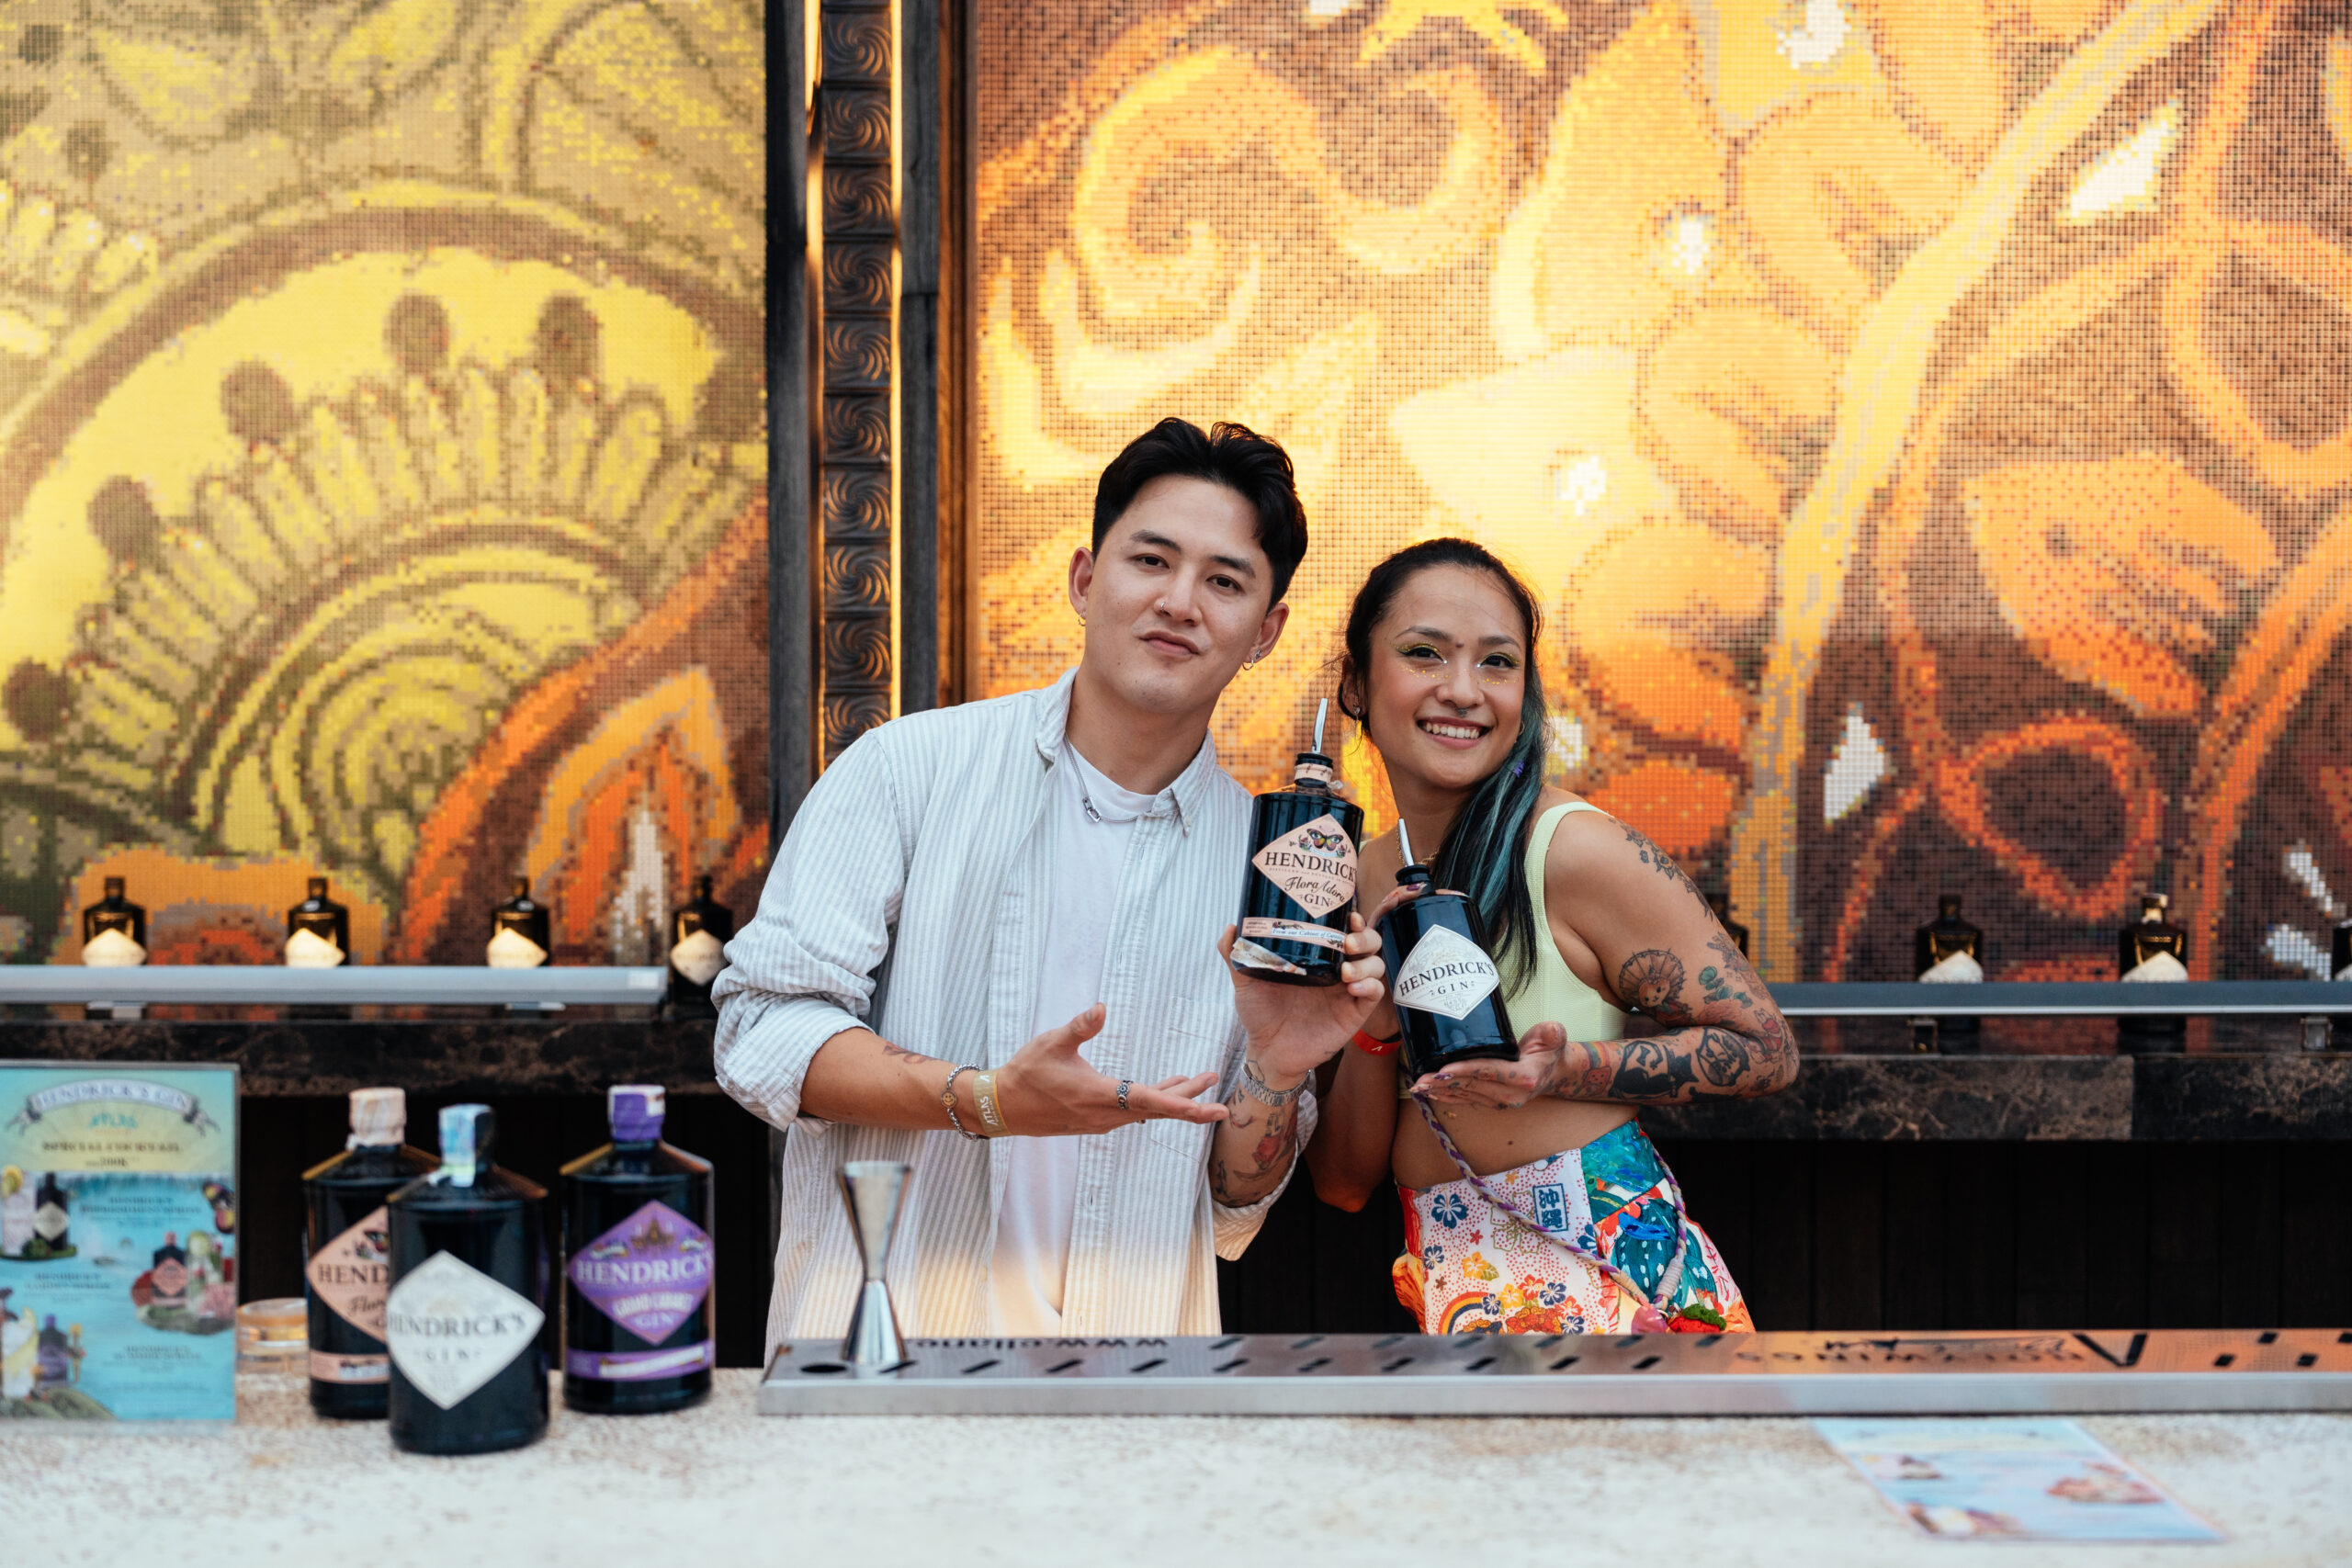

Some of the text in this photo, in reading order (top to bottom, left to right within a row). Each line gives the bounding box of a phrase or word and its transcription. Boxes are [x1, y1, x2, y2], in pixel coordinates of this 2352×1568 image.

[1284, 876, 1318, 893] Flora
[1312, 880, 1345, 901] Adora
[1305, 893, 1330, 907] GIN
[1399, 962, 1494, 997] HENDRICK'S
[1438, 981, 1468, 995] GIN
[980, 1096, 999, 1125] ATLAS
[318, 1264, 390, 1283] HEND
[348, 1296, 386, 1315] Flor
[389, 1312, 526, 1337] HENDRICK'S
[634, 1313, 673, 1327] GIN
[425, 1348, 469, 1362] GIN
